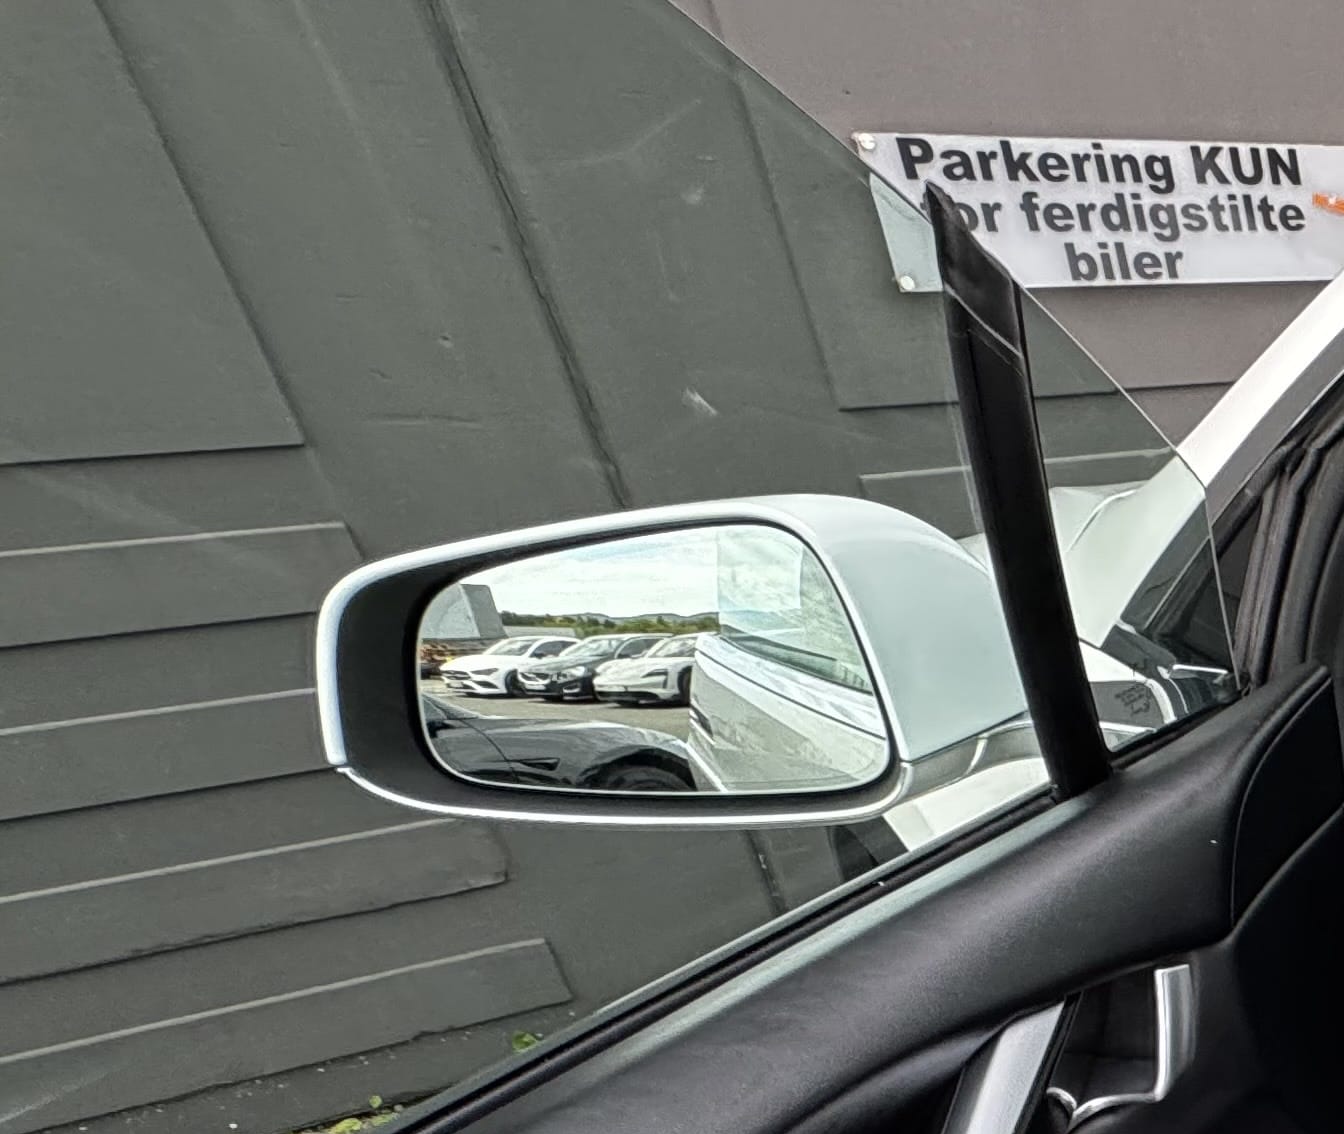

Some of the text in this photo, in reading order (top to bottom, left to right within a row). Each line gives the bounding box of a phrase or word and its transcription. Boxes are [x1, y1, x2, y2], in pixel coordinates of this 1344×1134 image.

[895, 136, 1303, 194] Parkering KUN
[920, 191, 1306, 242] or ferdigstilte
[1064, 242, 1184, 281] biler
